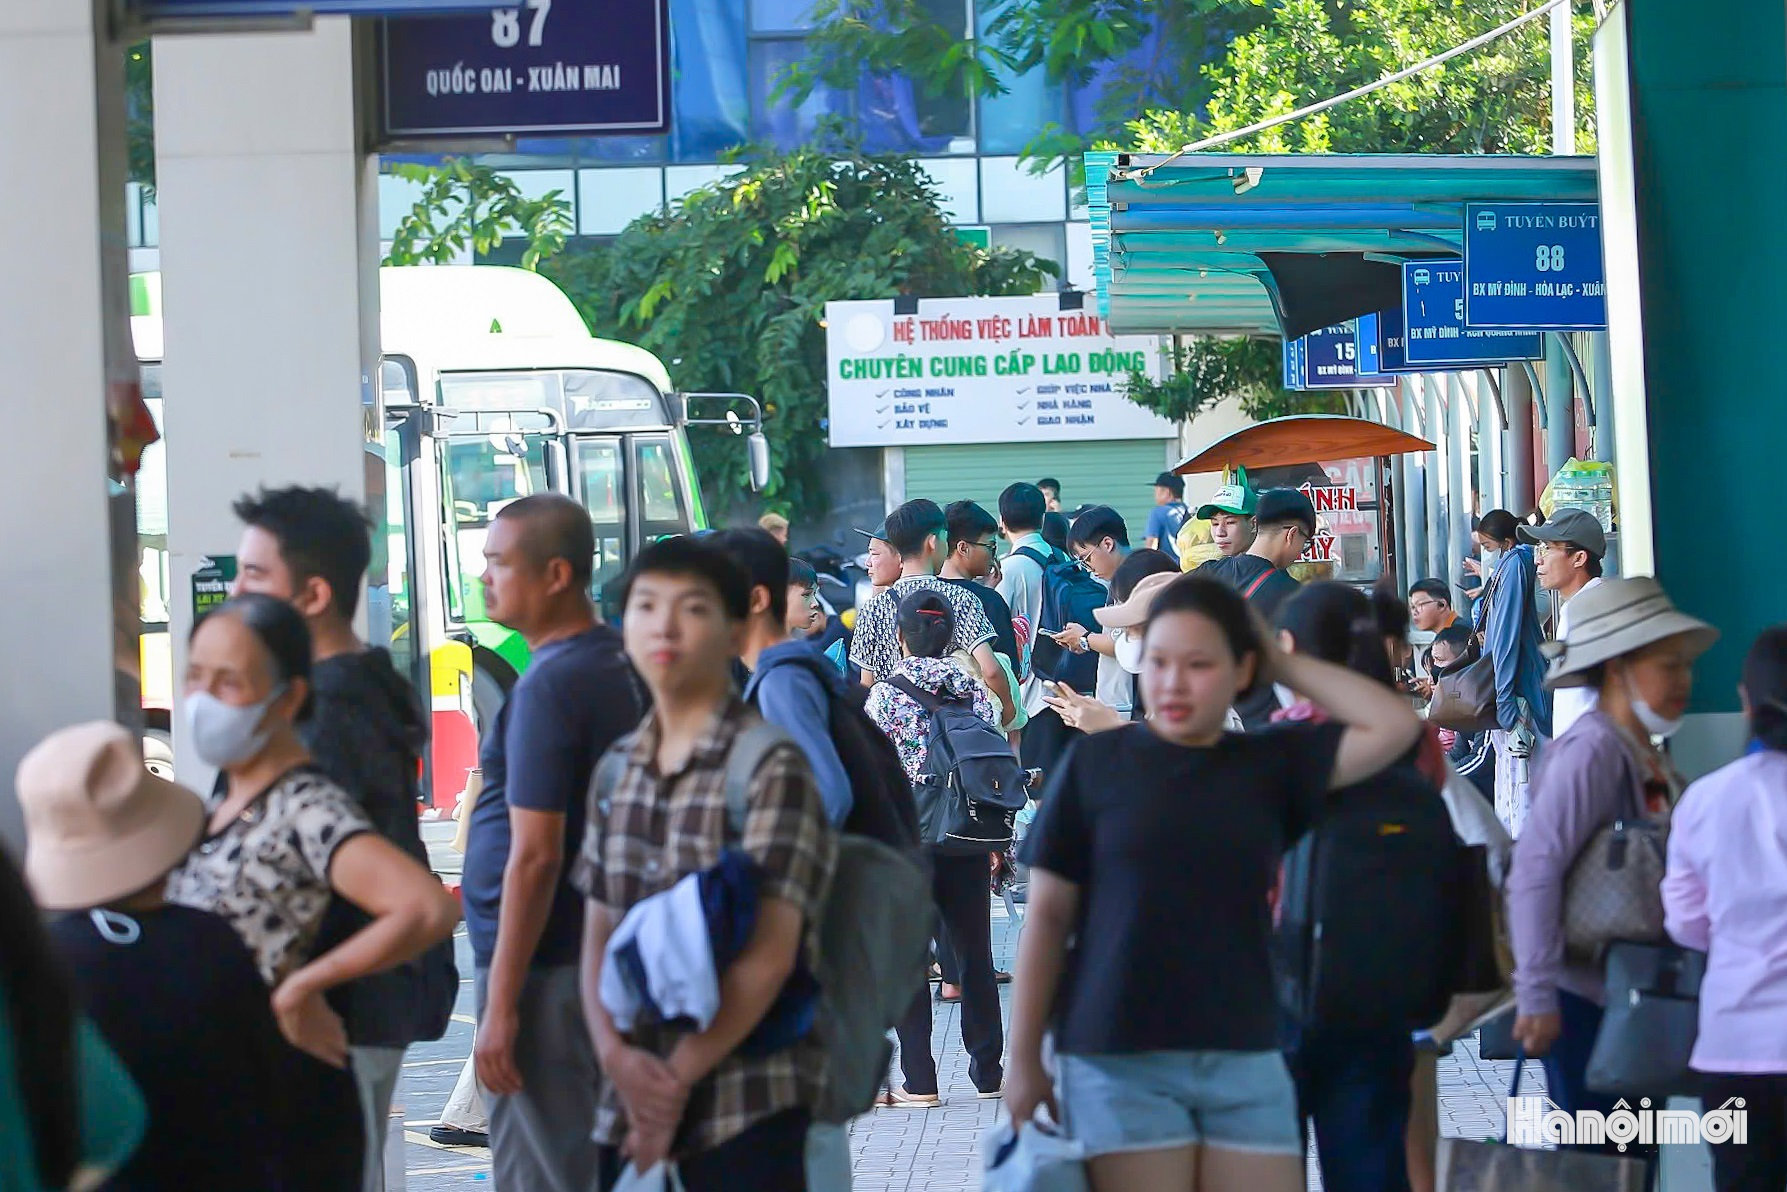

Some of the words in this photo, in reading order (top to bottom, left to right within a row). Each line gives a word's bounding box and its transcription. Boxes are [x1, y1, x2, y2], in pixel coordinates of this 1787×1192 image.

[491, 0, 551, 47] 87
[426, 61, 476, 97] QUỐC
[480, 67, 512, 93] OAI
[584, 65, 621, 90] MAI
[1535, 244, 1565, 272] 88
[1472, 282, 1486, 297] BX
[1487, 281, 1502, 297] MỸ
[1504, 280, 1527, 297] ĐÌNH
[1555, 282, 1574, 299] LẠC
[893, 316, 915, 345] HỆ
[920, 312, 972, 342] THỐNG
[977, 314, 1011, 343] VIỆC
[1018, 312, 1051, 339] LÀM
[1057, 311, 1099, 338] TOÀN
[1410, 327, 1422, 339] BX
[840, 352, 922, 379] CHUYÊN
[930, 355, 987, 378] CUNG
[994, 347, 1035, 377] CẤP
[1042, 352, 1081, 375] LAO
[1089, 347, 1145, 378] ĐỘNG
